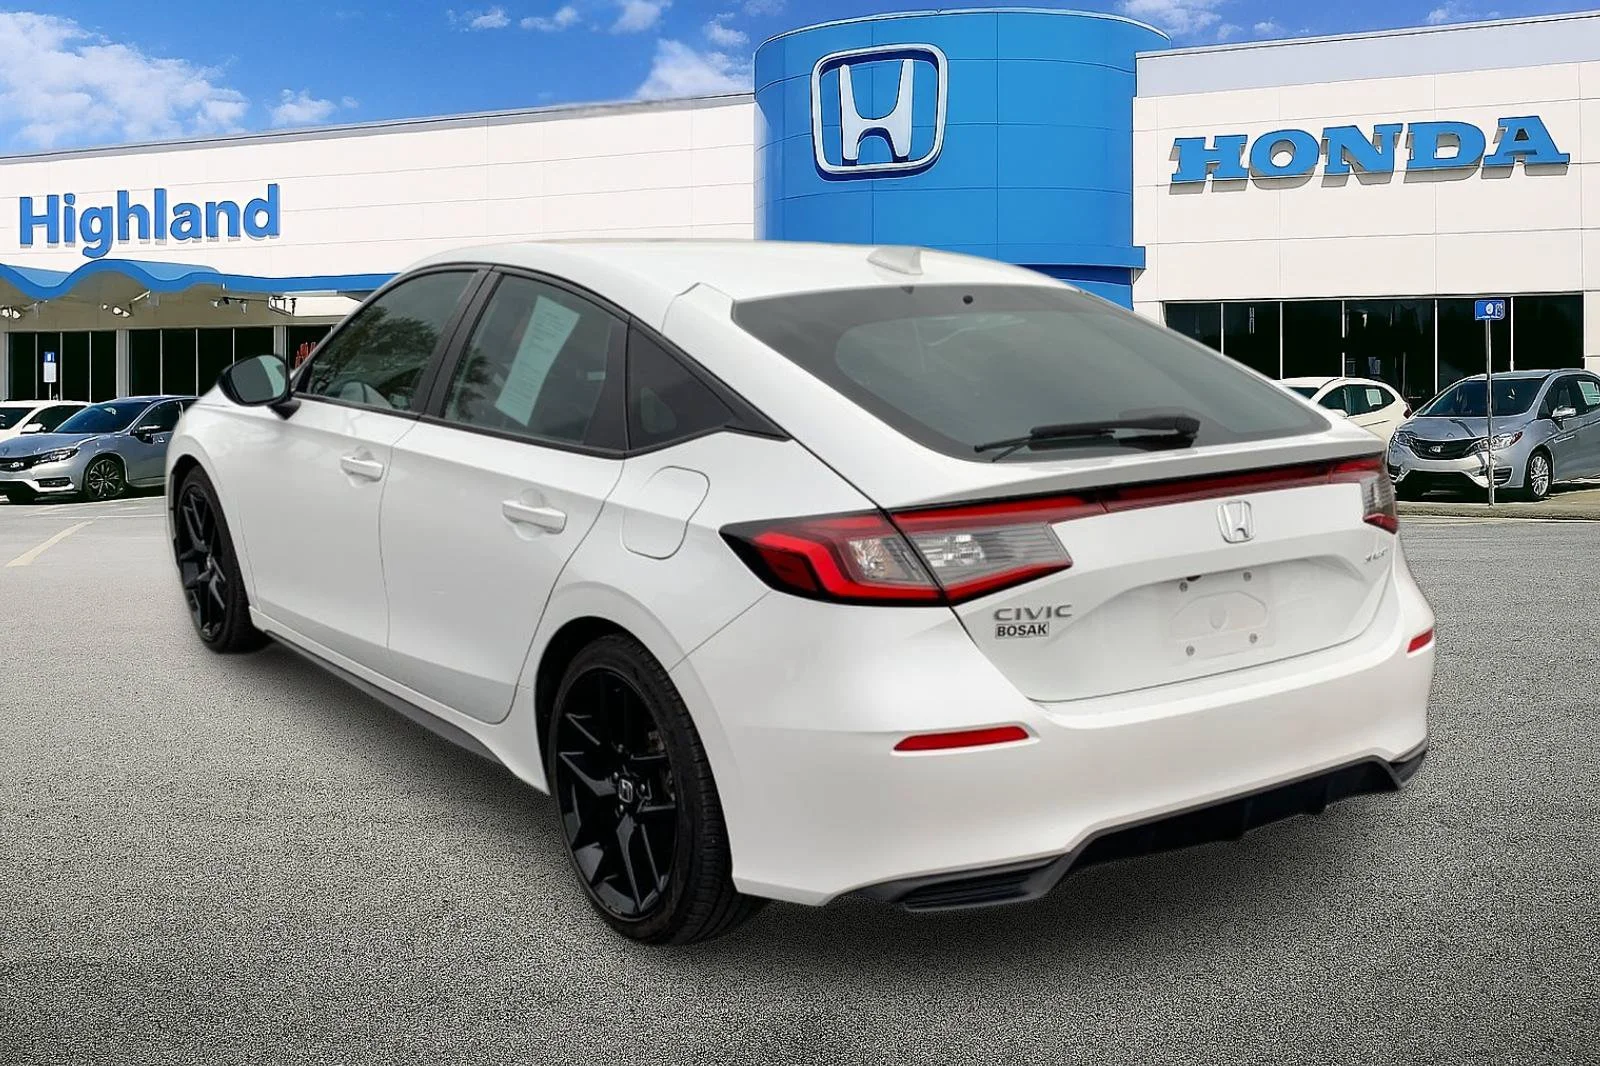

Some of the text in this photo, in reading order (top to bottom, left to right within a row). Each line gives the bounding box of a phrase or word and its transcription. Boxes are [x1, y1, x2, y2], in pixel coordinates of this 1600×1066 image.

[1170, 115, 1571, 185] HONDA
[19, 183, 281, 258] Highland
[994, 604, 1073, 621] CIVIC
[997, 623, 1047, 637] BOSAK
